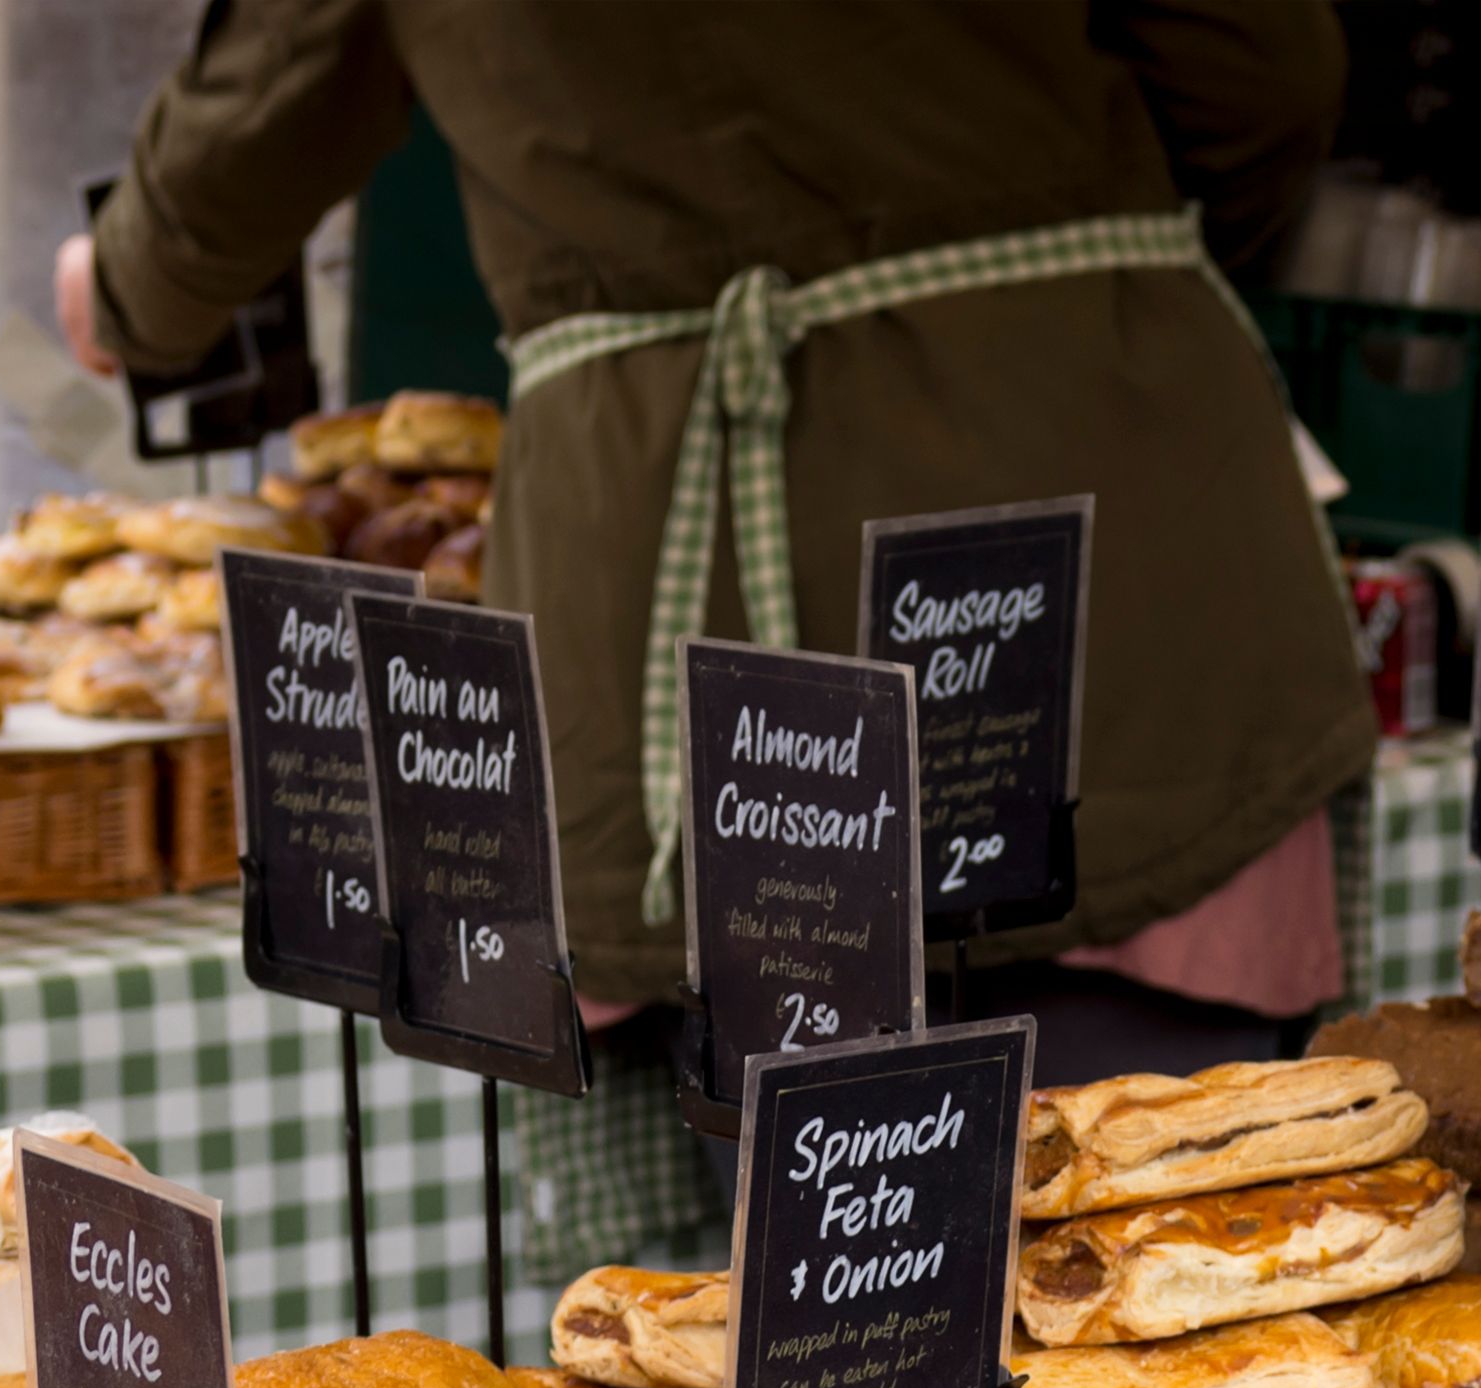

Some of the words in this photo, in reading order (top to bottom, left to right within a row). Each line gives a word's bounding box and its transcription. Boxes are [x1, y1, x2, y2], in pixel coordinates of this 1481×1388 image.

[278, 606, 356, 668] Apple
[889, 579, 1046, 644] Sausage
[265, 666, 369, 730] Strud
[387, 656, 447, 721] Pain
[457, 678, 500, 725] au
[921, 643, 995, 699] Roll
[398, 729, 516, 795] Chocolat
[731, 705, 864, 779] Almond
[424, 819, 461, 854] hand
[715, 781, 895, 851] Croissant
[424, 863, 448, 896] all
[755, 875, 838, 910] generously
[727, 909, 767, 939] filled
[773, 915, 802, 942] with
[811, 920, 870, 952] almond
[760, 955, 834, 986] patisserie
[788, 1091, 966, 1190] Spinach
[819, 1173, 914, 1240] Feta
[69, 1220, 172, 1316] Eccles
[822, 1239, 944, 1304] Onion
[78, 1303, 163, 1383] Cake
[766, 1321, 839, 1363] wrapped
[843, 1319, 858, 1344] in
[861, 1311, 901, 1343] puff
[900, 1306, 951, 1341] pastry
[843, 1357, 889, 1386] eaten
[895, 1347, 927, 1374] hot
